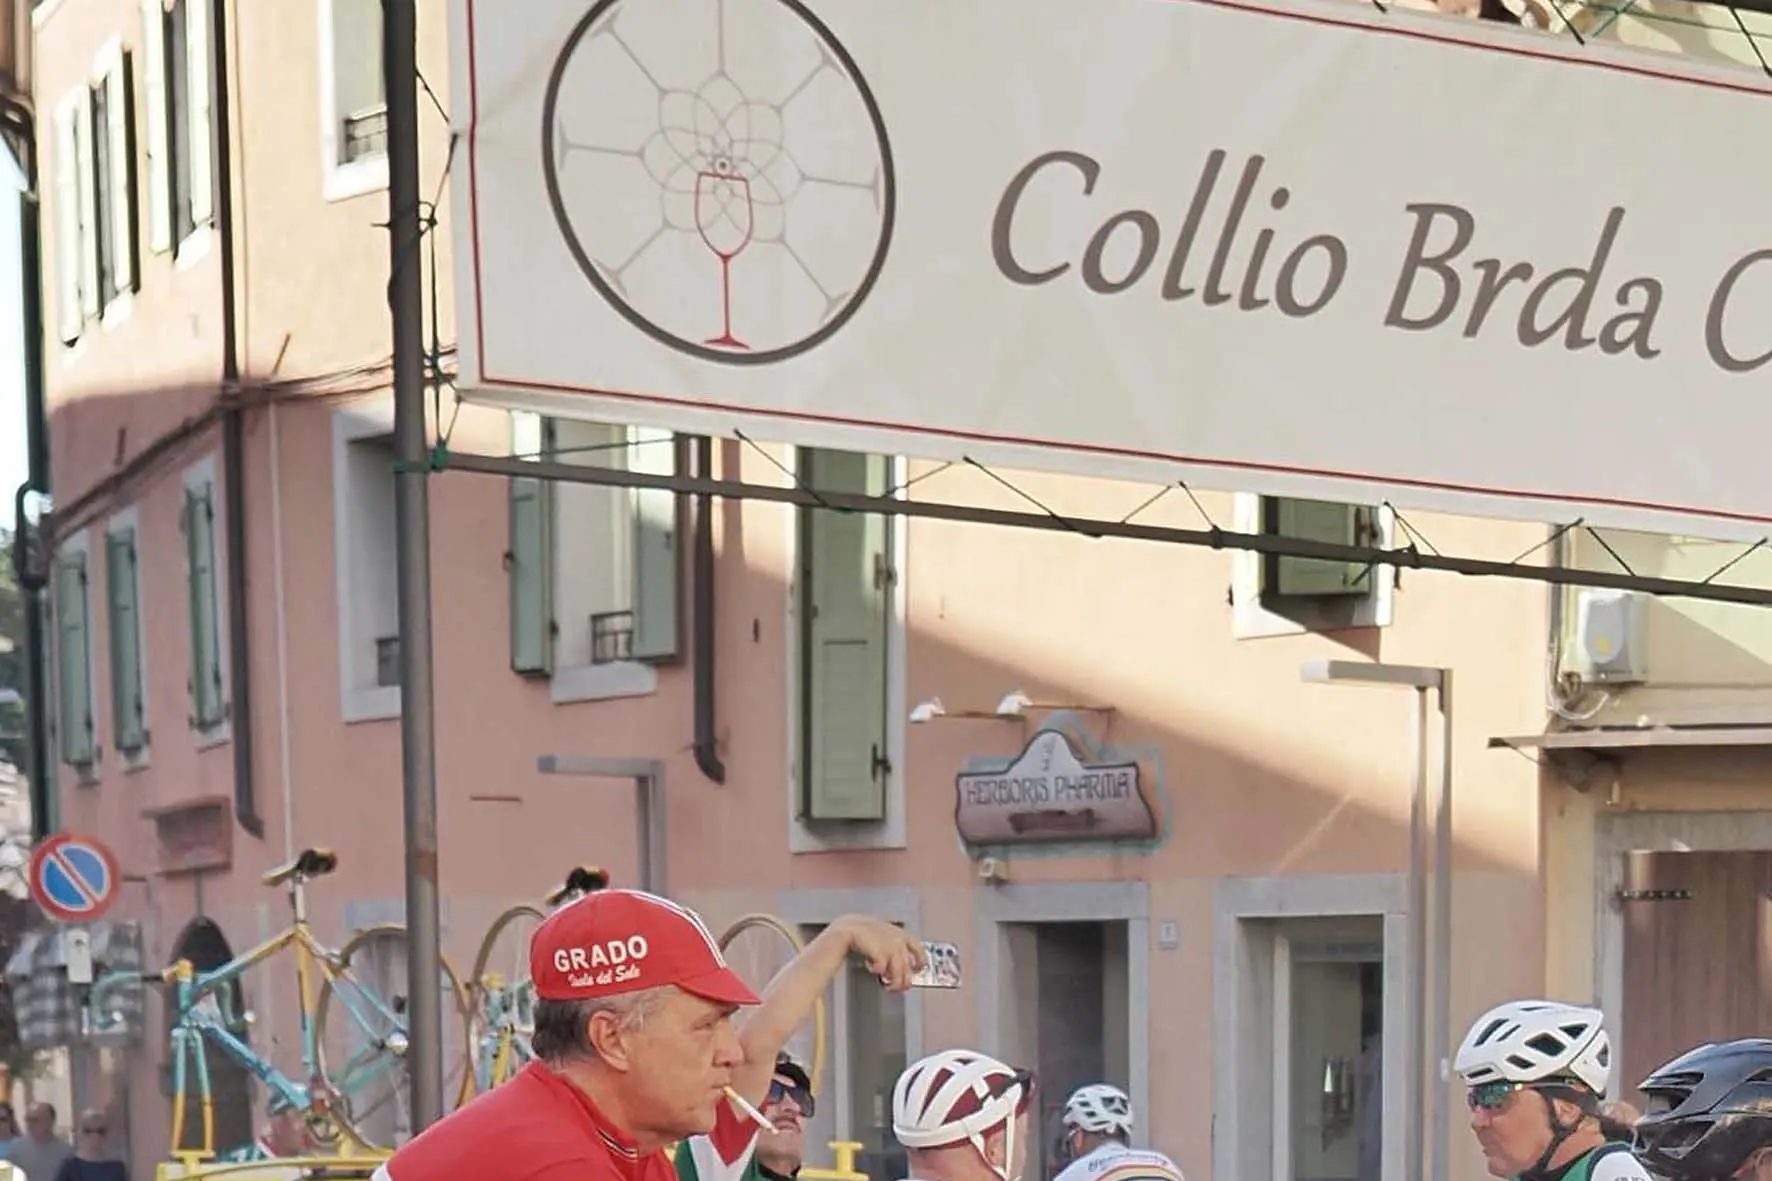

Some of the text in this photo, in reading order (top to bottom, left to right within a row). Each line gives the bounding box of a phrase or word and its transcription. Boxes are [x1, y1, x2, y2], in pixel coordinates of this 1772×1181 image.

[991, 149, 1348, 317] Collio
[1385, 203, 1663, 360] Brda
[554, 935, 648, 972] GRADO
